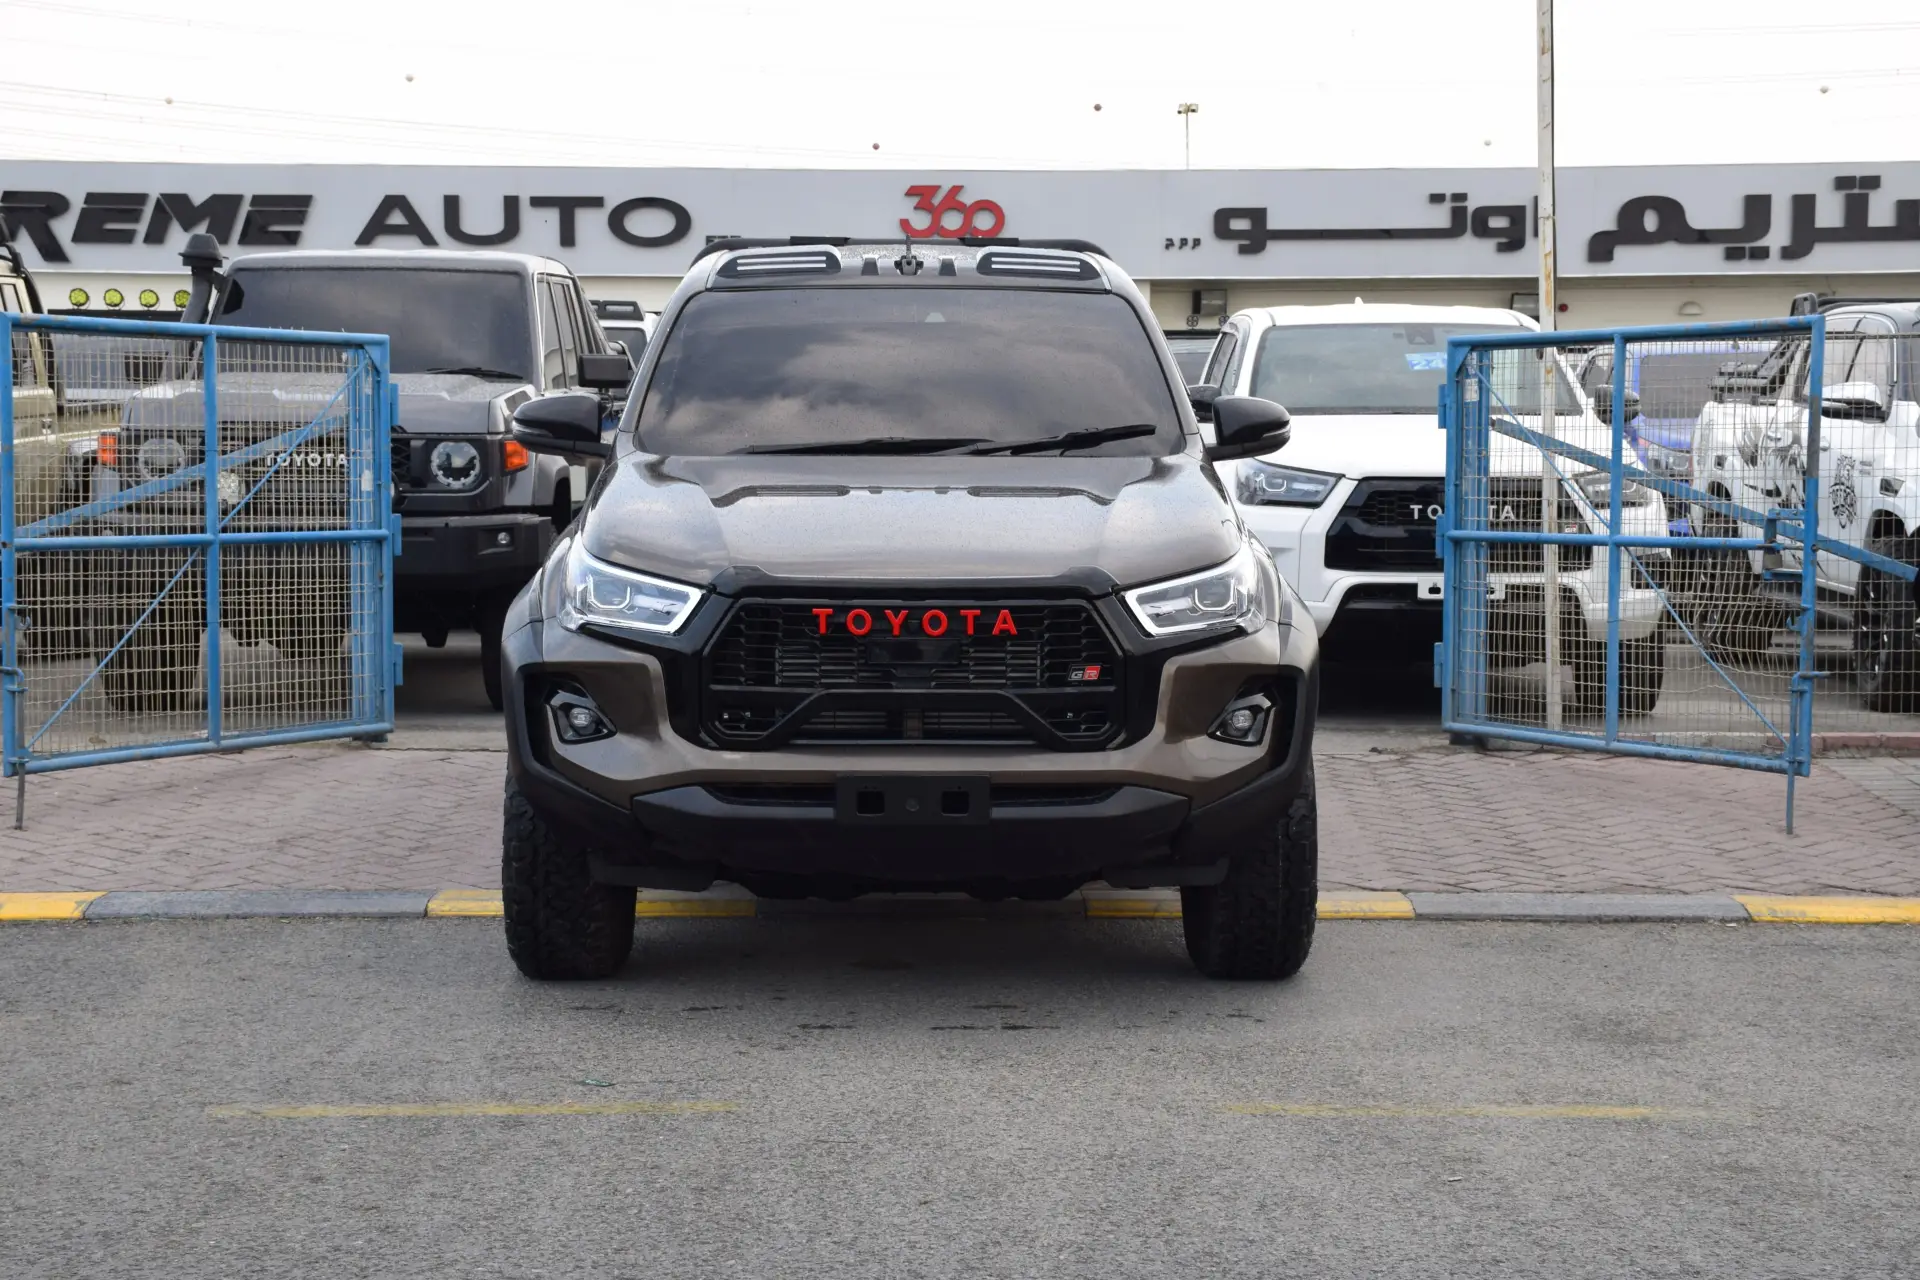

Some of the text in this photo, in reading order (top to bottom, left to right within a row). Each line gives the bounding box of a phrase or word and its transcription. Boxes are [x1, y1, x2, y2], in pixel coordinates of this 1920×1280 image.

[354, 194, 692, 248] AUTO
[899, 185, 1005, 238] 360
[266, 453, 349, 467] TOYOTA
[1410, 504, 1516, 520] TOTA
[812, 608, 1018, 636] TOYOTA
